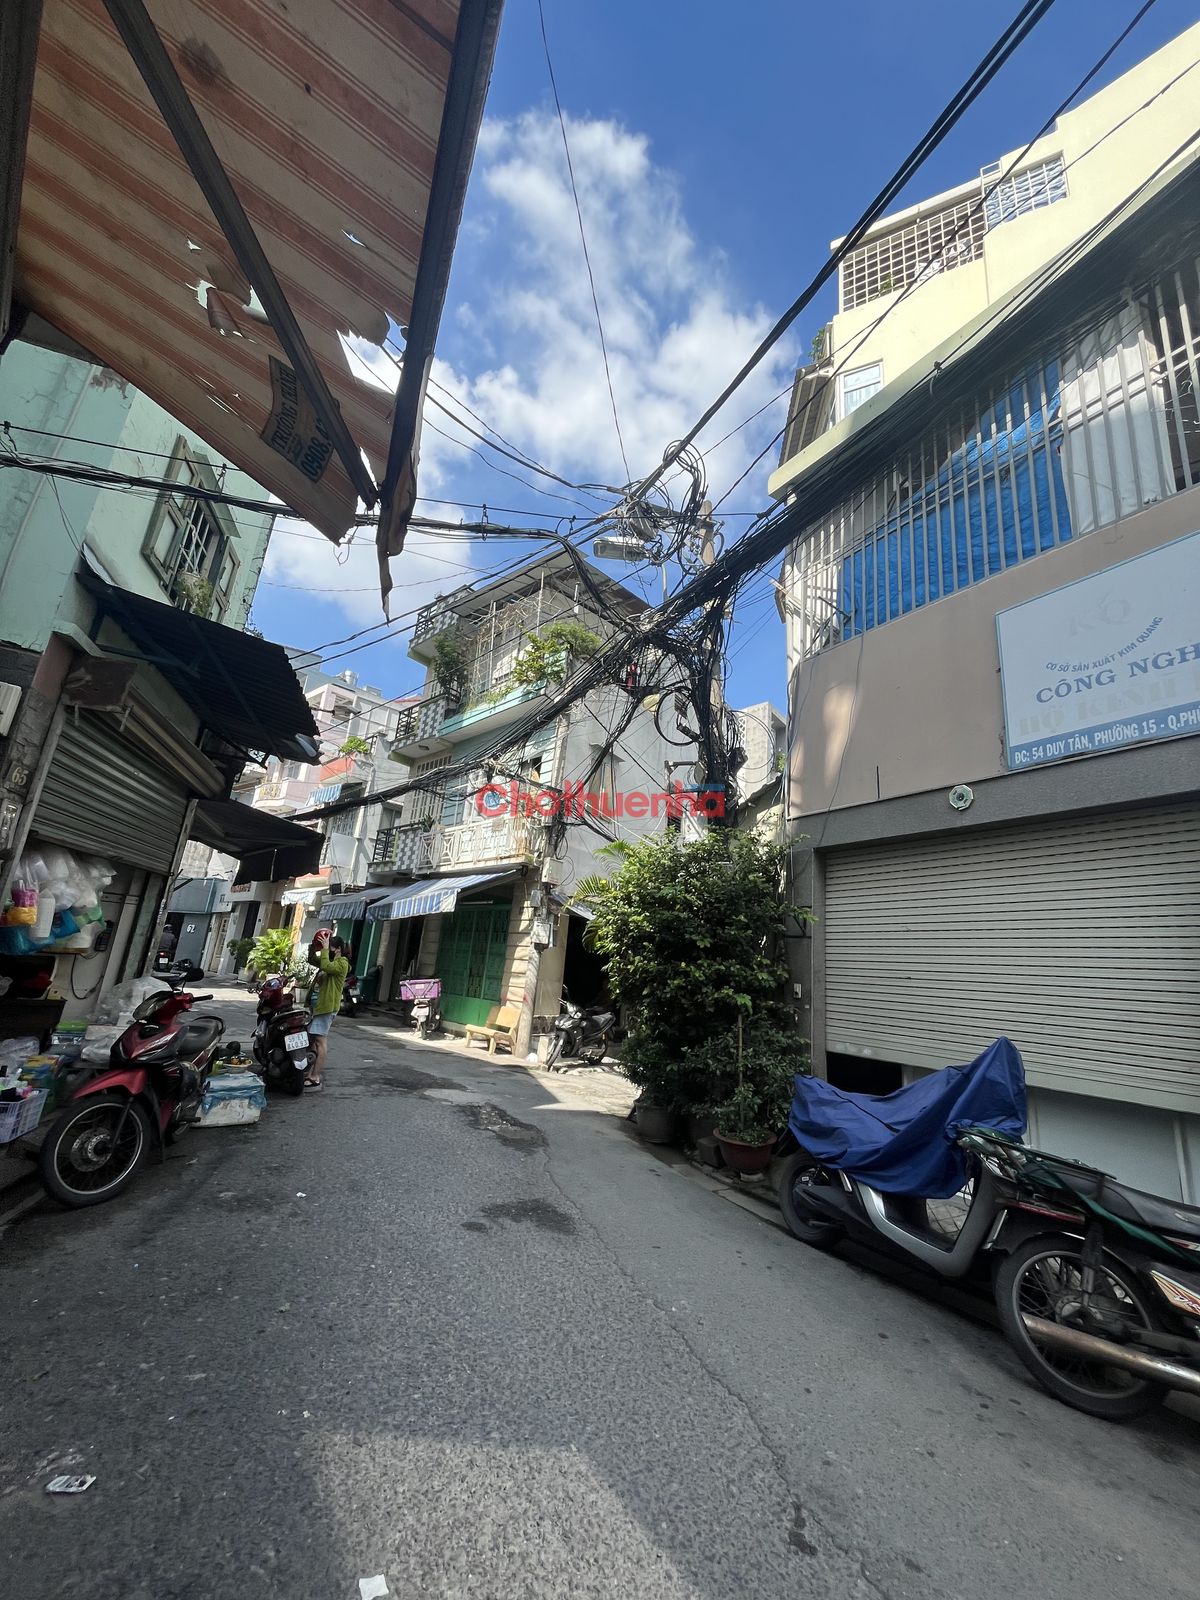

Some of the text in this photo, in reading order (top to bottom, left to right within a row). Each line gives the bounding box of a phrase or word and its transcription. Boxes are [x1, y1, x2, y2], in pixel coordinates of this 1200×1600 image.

[1117, 642, 1137, 657] KIM
[1136, 616, 1163, 643] QUANG
[1036, 669, 1116, 703] CÔNG
[1015, 752, 1030, 764] ĐC:
[1032, 747, 1044, 760] 54
[1046, 741, 1065, 757] DUY
[1068, 735, 1092, 752] TÂN,
[1094, 723, 1139, 745] PHƯỜNG
[1142, 719, 1157, 735] 15
[11, 766, 29, 786] 65
